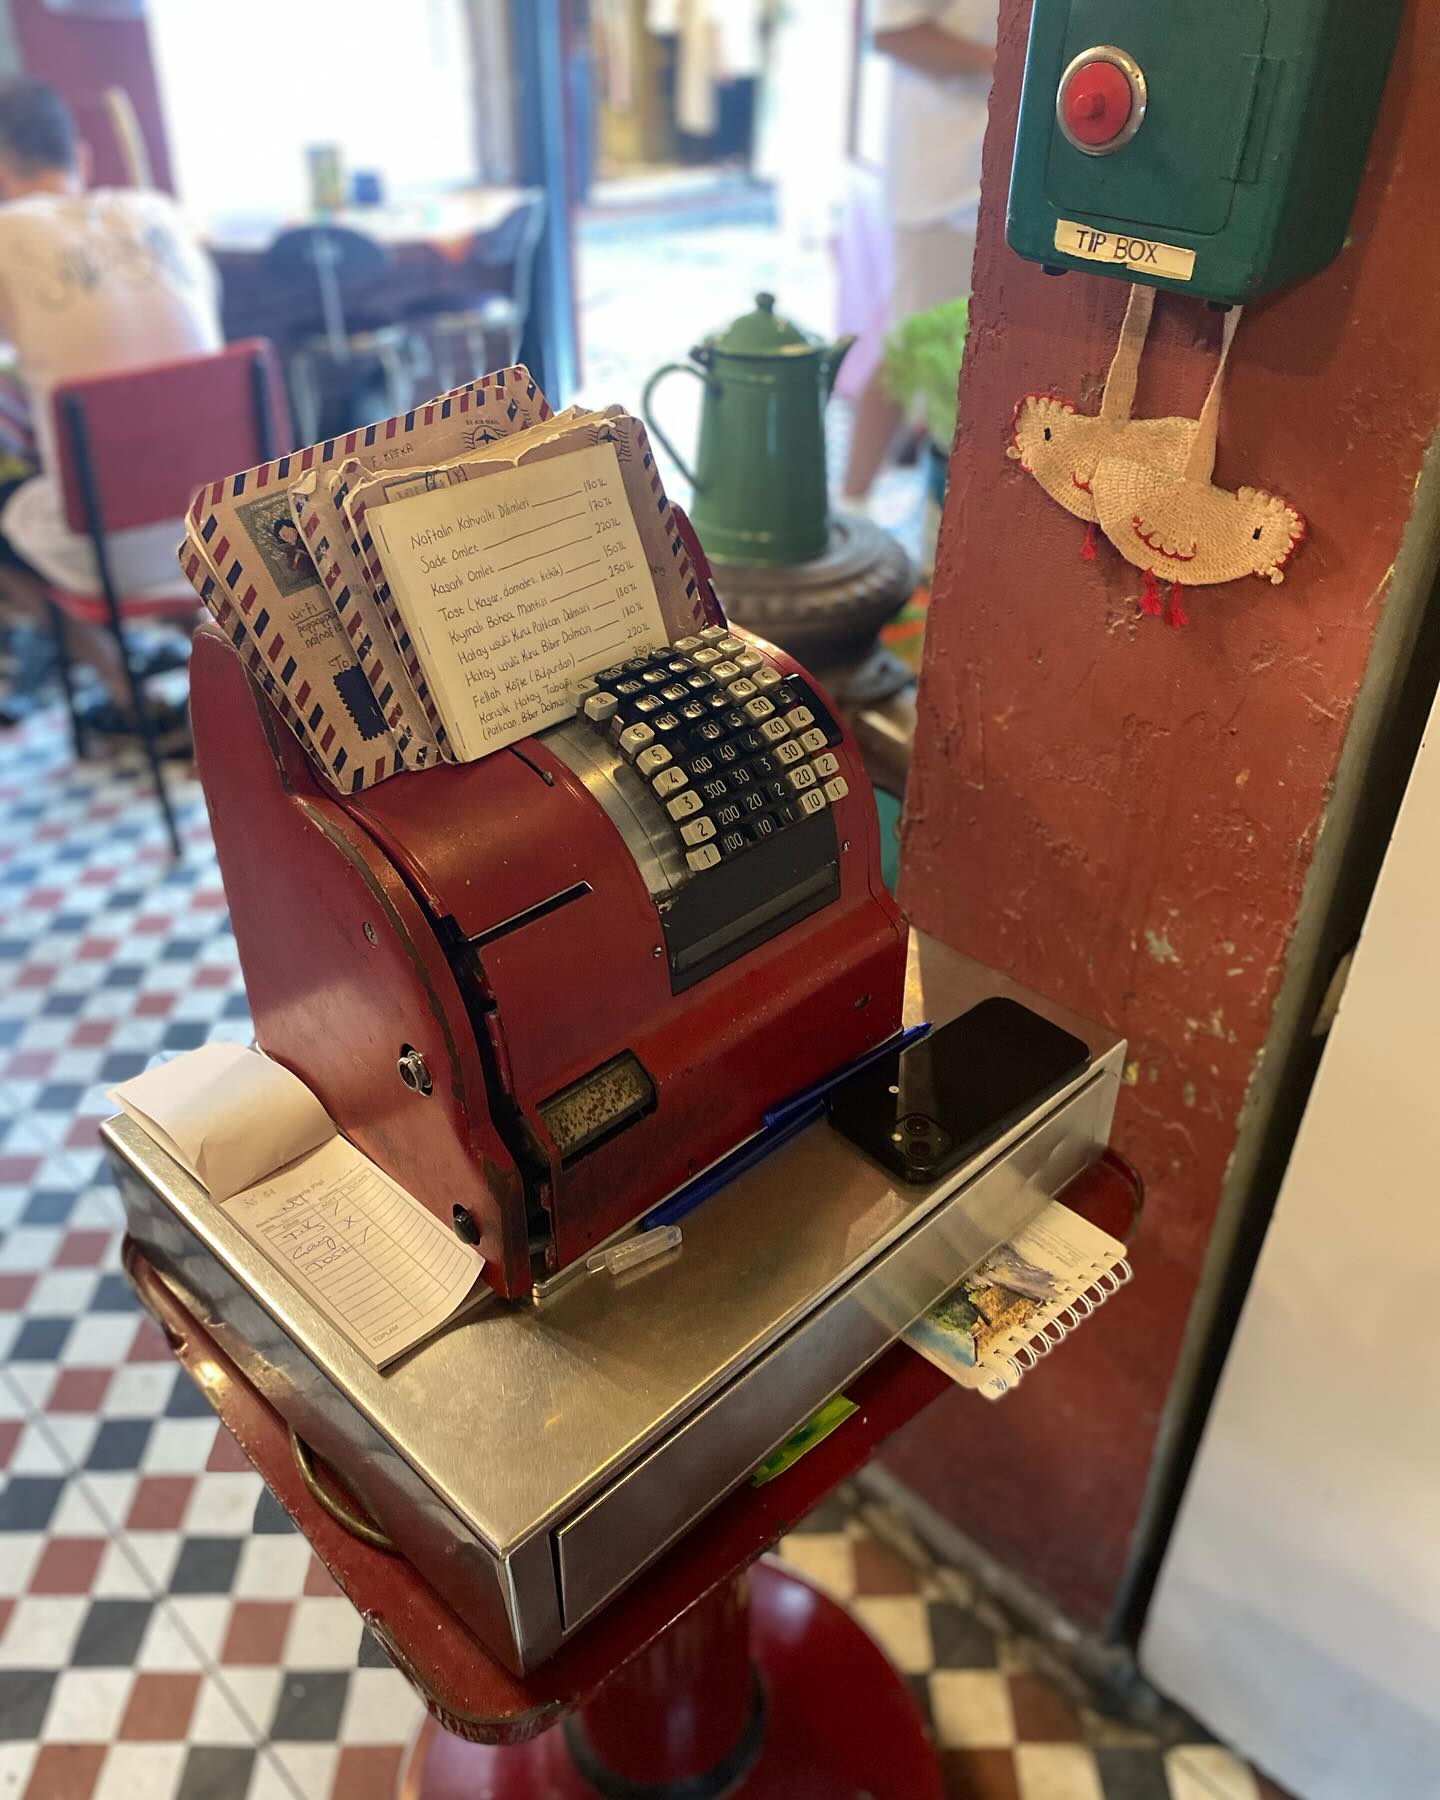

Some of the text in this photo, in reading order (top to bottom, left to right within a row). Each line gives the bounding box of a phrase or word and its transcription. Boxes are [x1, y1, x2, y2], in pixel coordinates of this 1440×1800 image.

[1076, 230, 1158, 264] TIP BOX
[410, 523, 454, 549] Naftalin
[498, 496, 530, 519] Dilimleri
[420, 552, 448, 574] Sade
[451, 543, 480, 561] Omlet
[467, 565, 495, 582] Omlet
[437, 607, 465, 622] Tost
[457, 646, 491, 665] Hatay
[511, 627, 532, 642] Kuru
[464, 667, 497, 688] Hatay
[522, 648, 540, 662] Kuru
[540, 638, 561, 654] Biber
[472, 687, 501, 709] Fellah
[504, 678, 528, 694] Köfte
[597, 697, 608, 705] 8
[779, 690, 792, 704] 5
[514, 693, 542, 710] Hatay
[752, 700, 769, 713] 50
[520, 710, 539, 723] Biber
[730, 713, 742, 726] 5
[797, 712, 806, 722] 4
[633, 728, 645, 739] 6
[701, 722, 720, 739] 50
[768, 720, 785, 735] 40
[748, 735, 759, 747] 4
[811, 733, 822, 746] 3
[652, 750, 662, 762] 5
[719, 744, 736, 762] 40
[781, 744, 799, 759] 30
[690, 757, 714, 776] 400
[761, 757, 772, 771] 3
[822, 758, 833, 772] 2
[669, 772, 679, 785] 4
[732, 767, 750, 784] 30
[795, 769, 812, 784] 20
[704, 779, 727, 798] 300
[774, 783, 785, 796] 2
[832, 783, 840, 795] 1
[684, 795, 694, 810] 3
[746, 793, 763, 810] 20
[807, 792, 821, 808] 10
[718, 805, 740, 825] 200
[785, 808, 793, 820] 1
[698, 822, 709, 838] 2
[758, 818, 772, 835] 10
[724, 832, 744, 852] 100
[703, 850, 711, 864] 1
